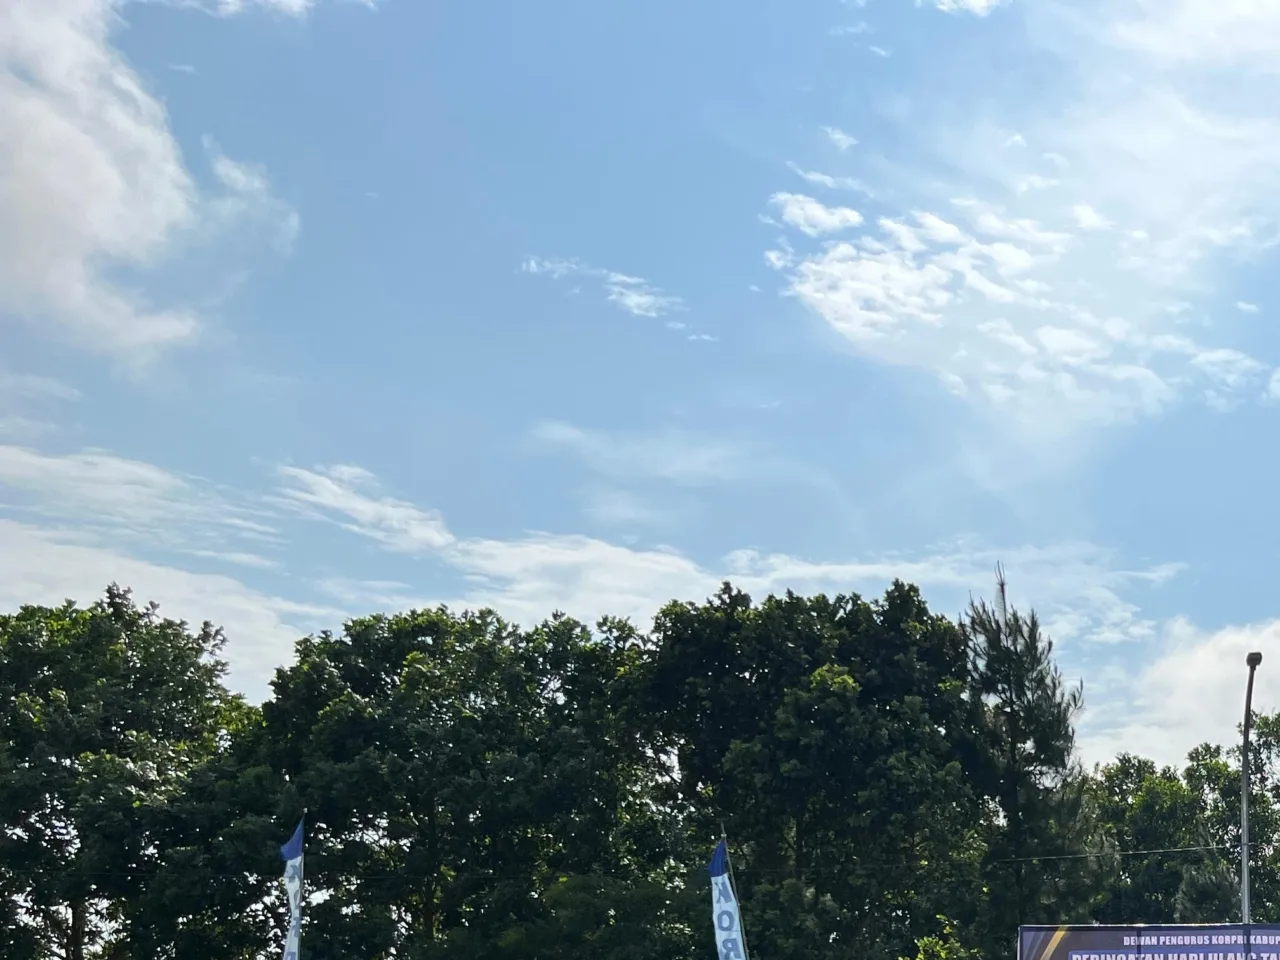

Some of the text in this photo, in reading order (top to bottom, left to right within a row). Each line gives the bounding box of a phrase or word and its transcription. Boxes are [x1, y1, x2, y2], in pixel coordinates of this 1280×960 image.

[1123, 936, 1158, 946] DEWAN
[1159, 935, 1210, 946] PENGURUS
[1211, 935, 1247, 945] KORPRI
